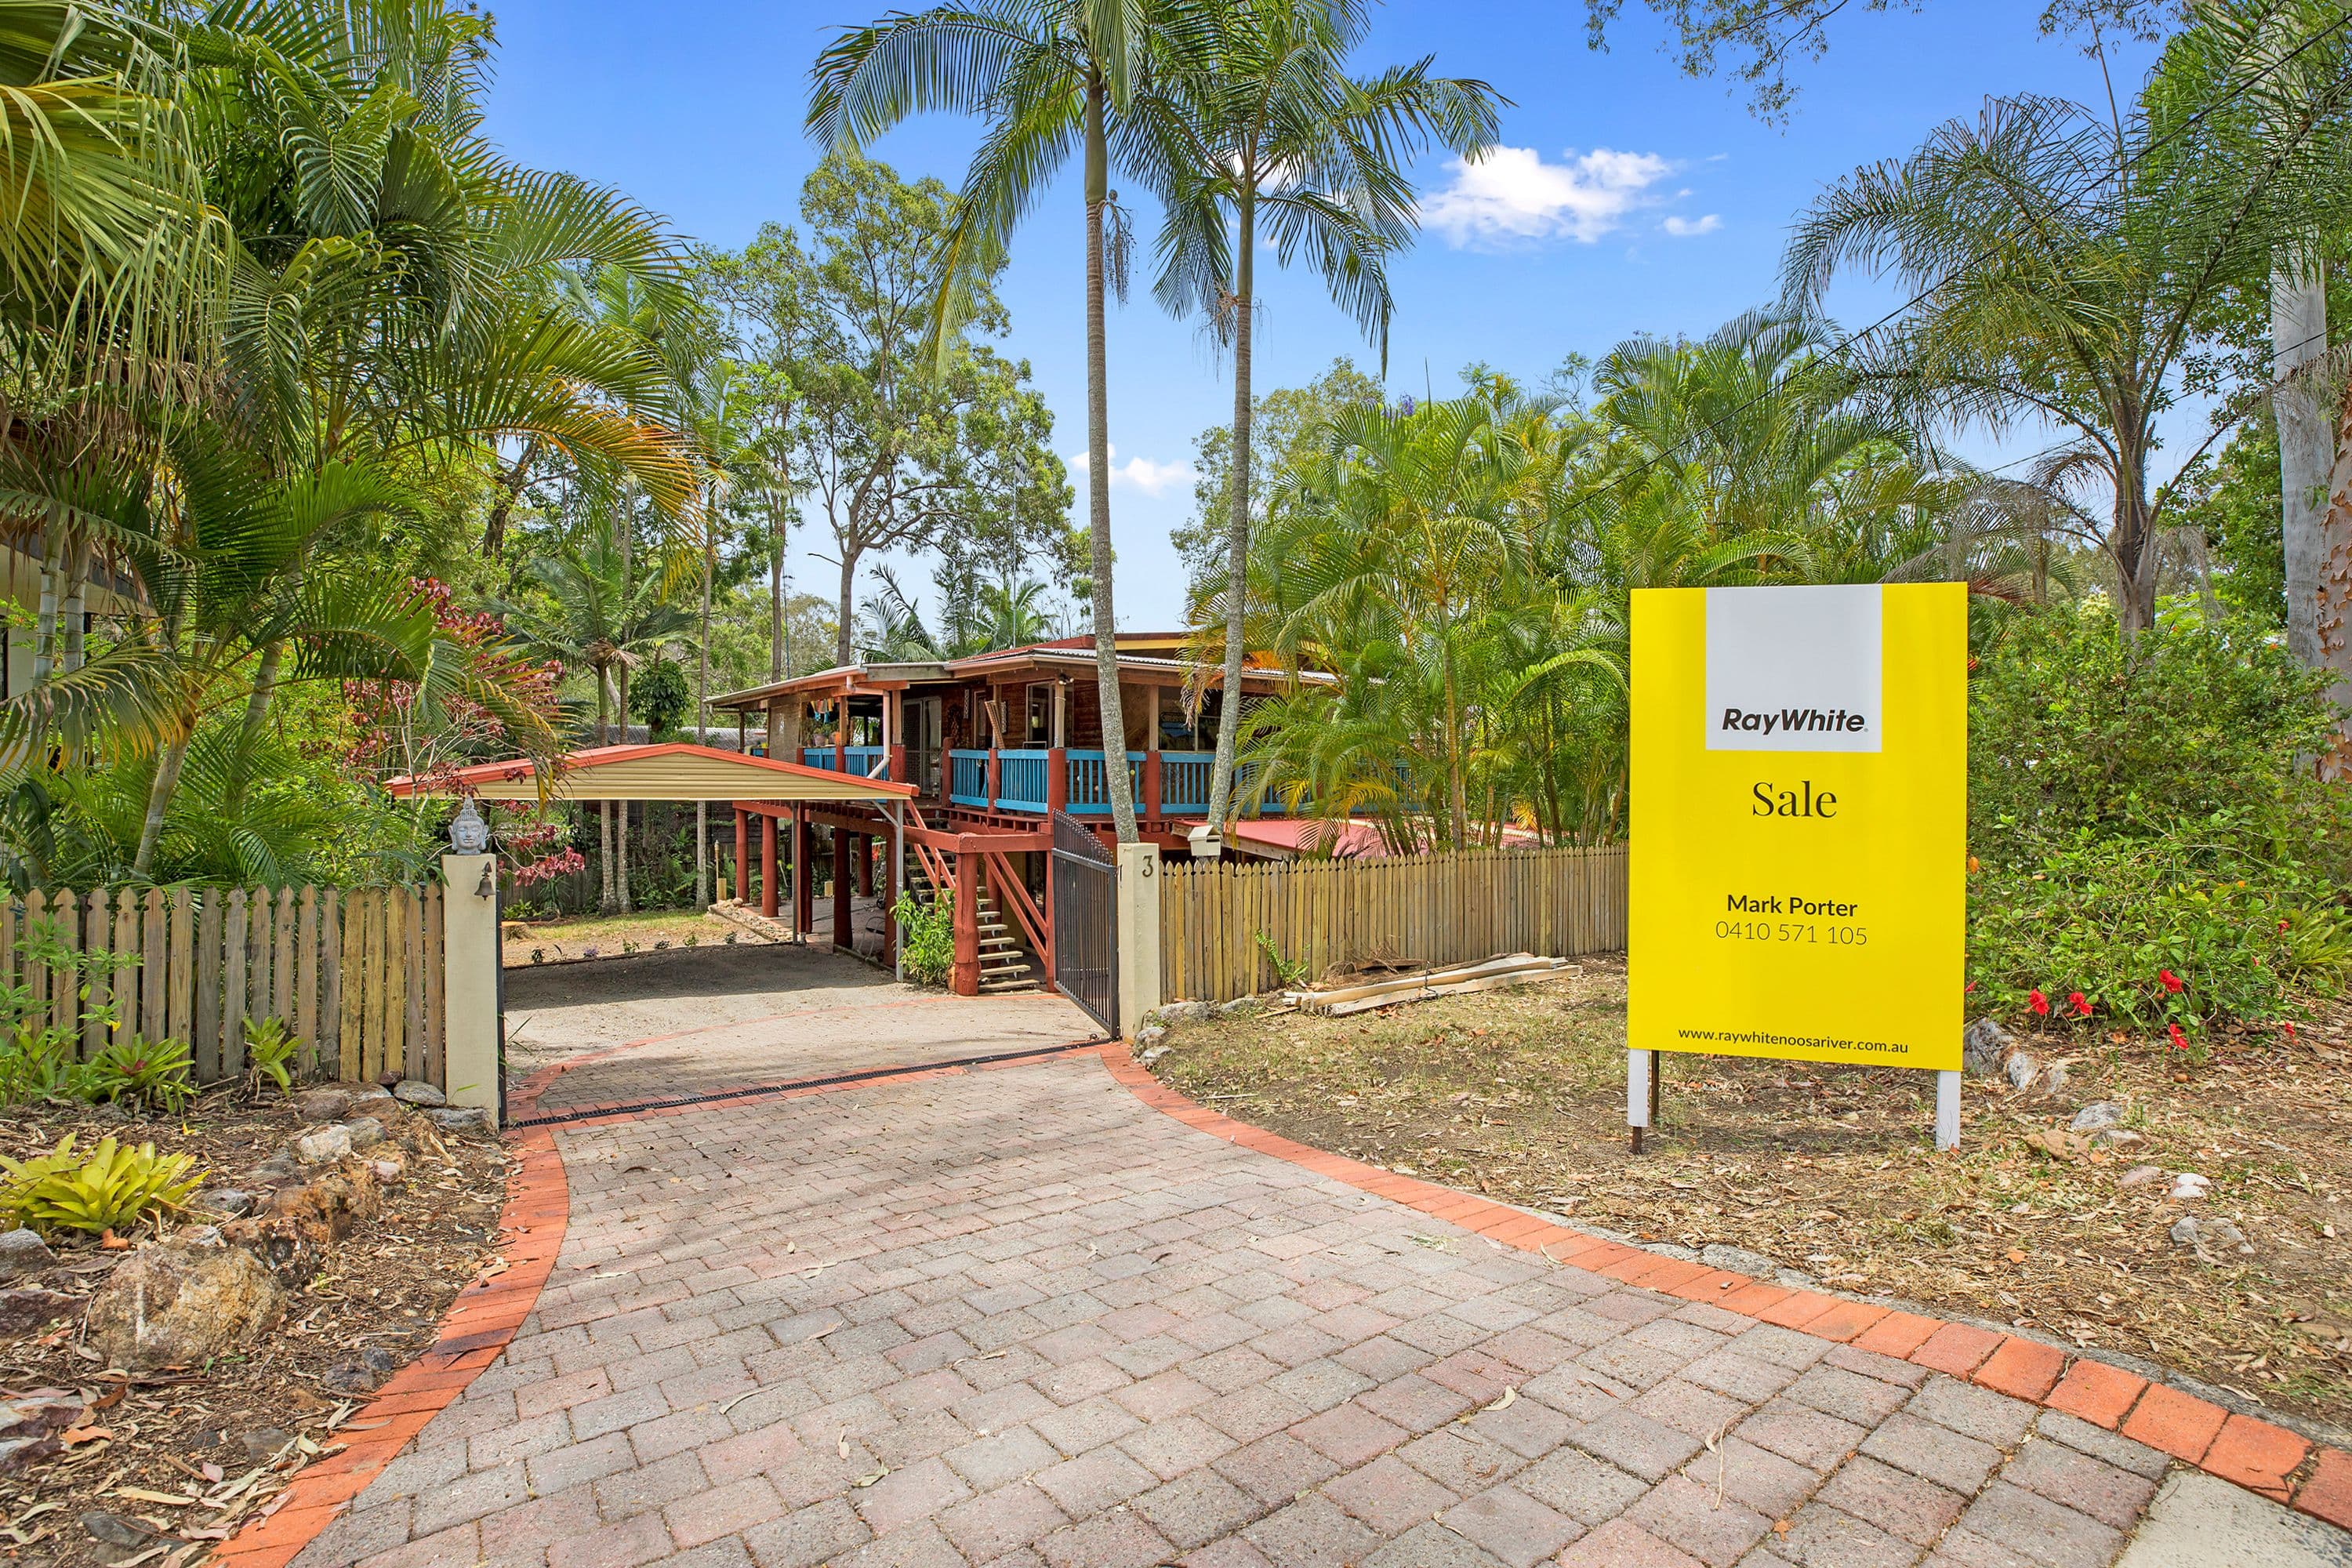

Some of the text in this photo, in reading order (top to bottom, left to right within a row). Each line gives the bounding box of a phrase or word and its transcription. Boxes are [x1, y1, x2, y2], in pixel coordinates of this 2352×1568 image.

[1752, 780, 1837, 818] Sale
[1142, 855, 1154, 878] 3
[1727, 894, 1858, 917] Mark Porter
[1715, 920, 1867, 946] 0410 571 105
[1678, 1029, 1909, 1054] www.raywhitenoosariver.com.au
